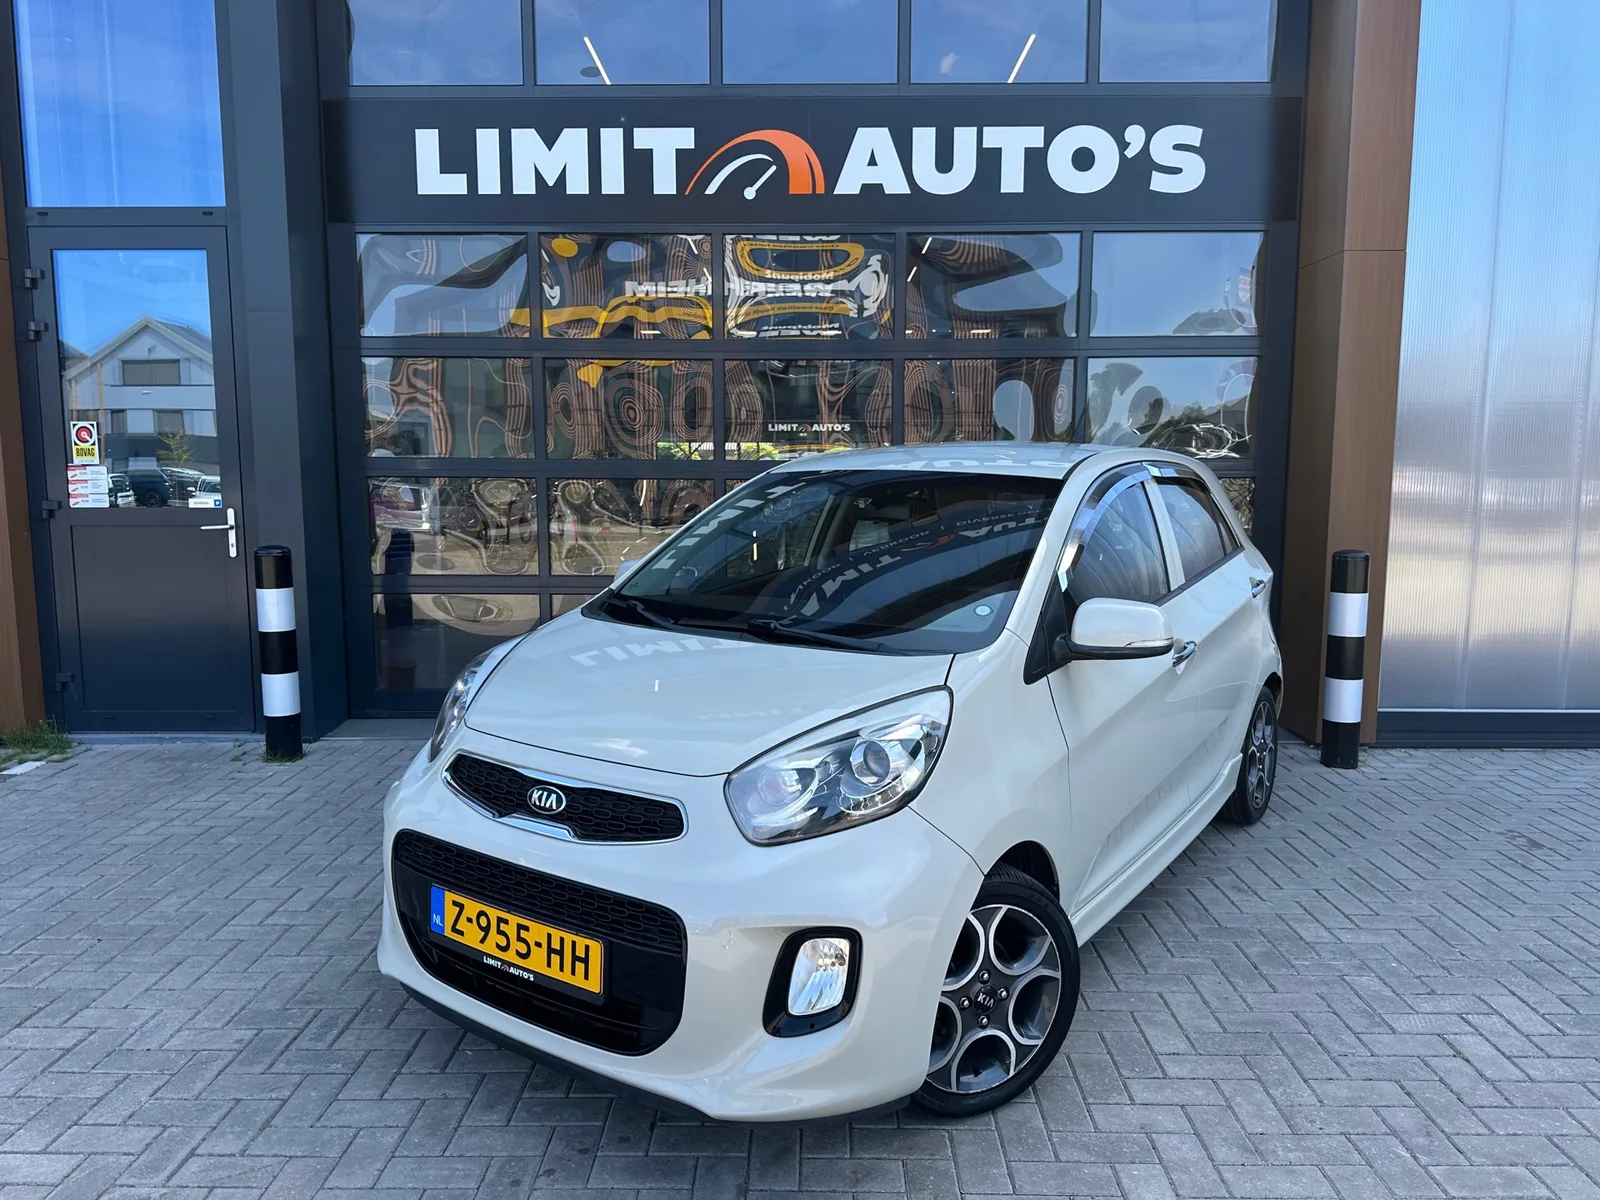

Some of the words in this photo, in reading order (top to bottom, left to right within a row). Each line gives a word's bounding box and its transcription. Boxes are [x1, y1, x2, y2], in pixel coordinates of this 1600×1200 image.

[415, 127, 695, 196] LIMIT
[833, 124, 1206, 195] AUTO'S
[768, 423, 798, 432] LIMIT
[812, 423, 851, 432] AUTO'S
[75, 447, 95, 457] BOVAG
[531, 789, 557, 810] KIA
[432, 913, 443, 927] NL
[450, 899, 590, 981] Z-955-HH
[483, 955, 502, 969] LIMIT
[509, 966, 534, 982] AUTO'S
[978, 993, 994, 1007] KIA
